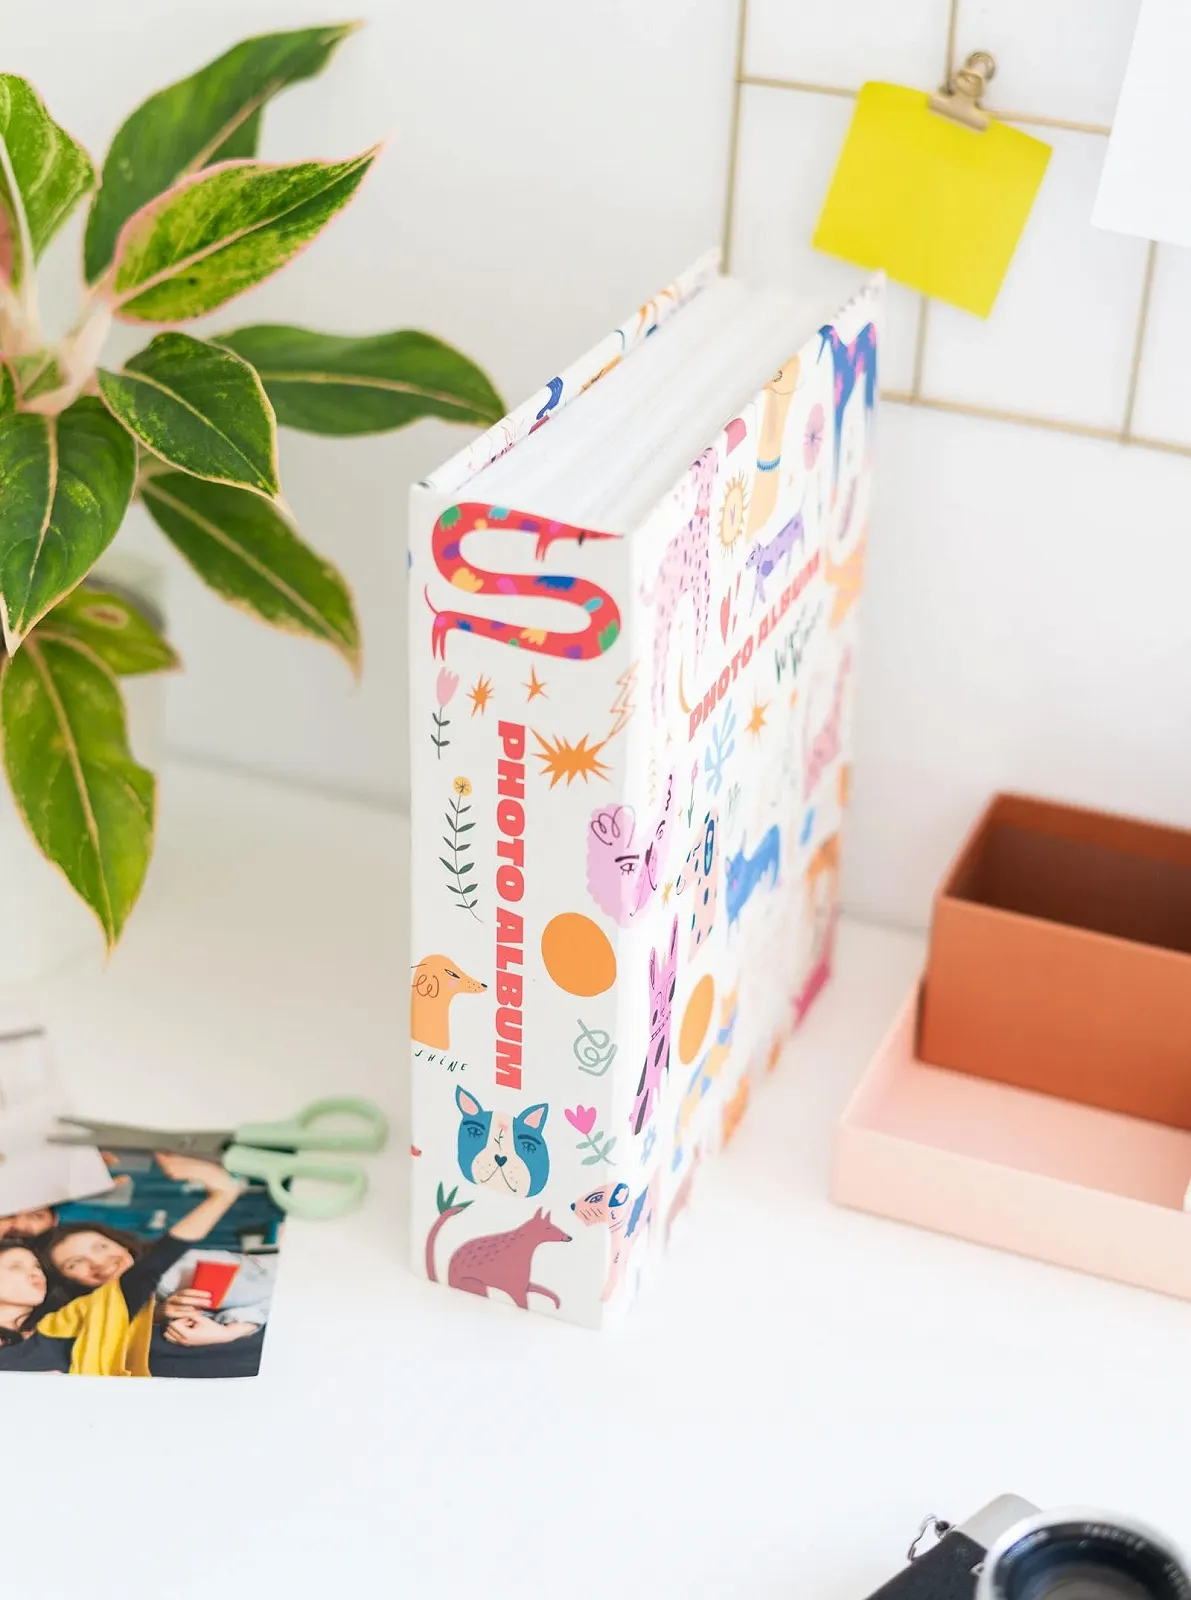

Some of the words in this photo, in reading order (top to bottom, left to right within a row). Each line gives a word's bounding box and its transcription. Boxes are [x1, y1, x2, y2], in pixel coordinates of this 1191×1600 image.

[688, 634, 754, 743] PHOTO
[495, 720, 526, 903] PHOTO
[494, 906, 525, 1091] ALBUM
